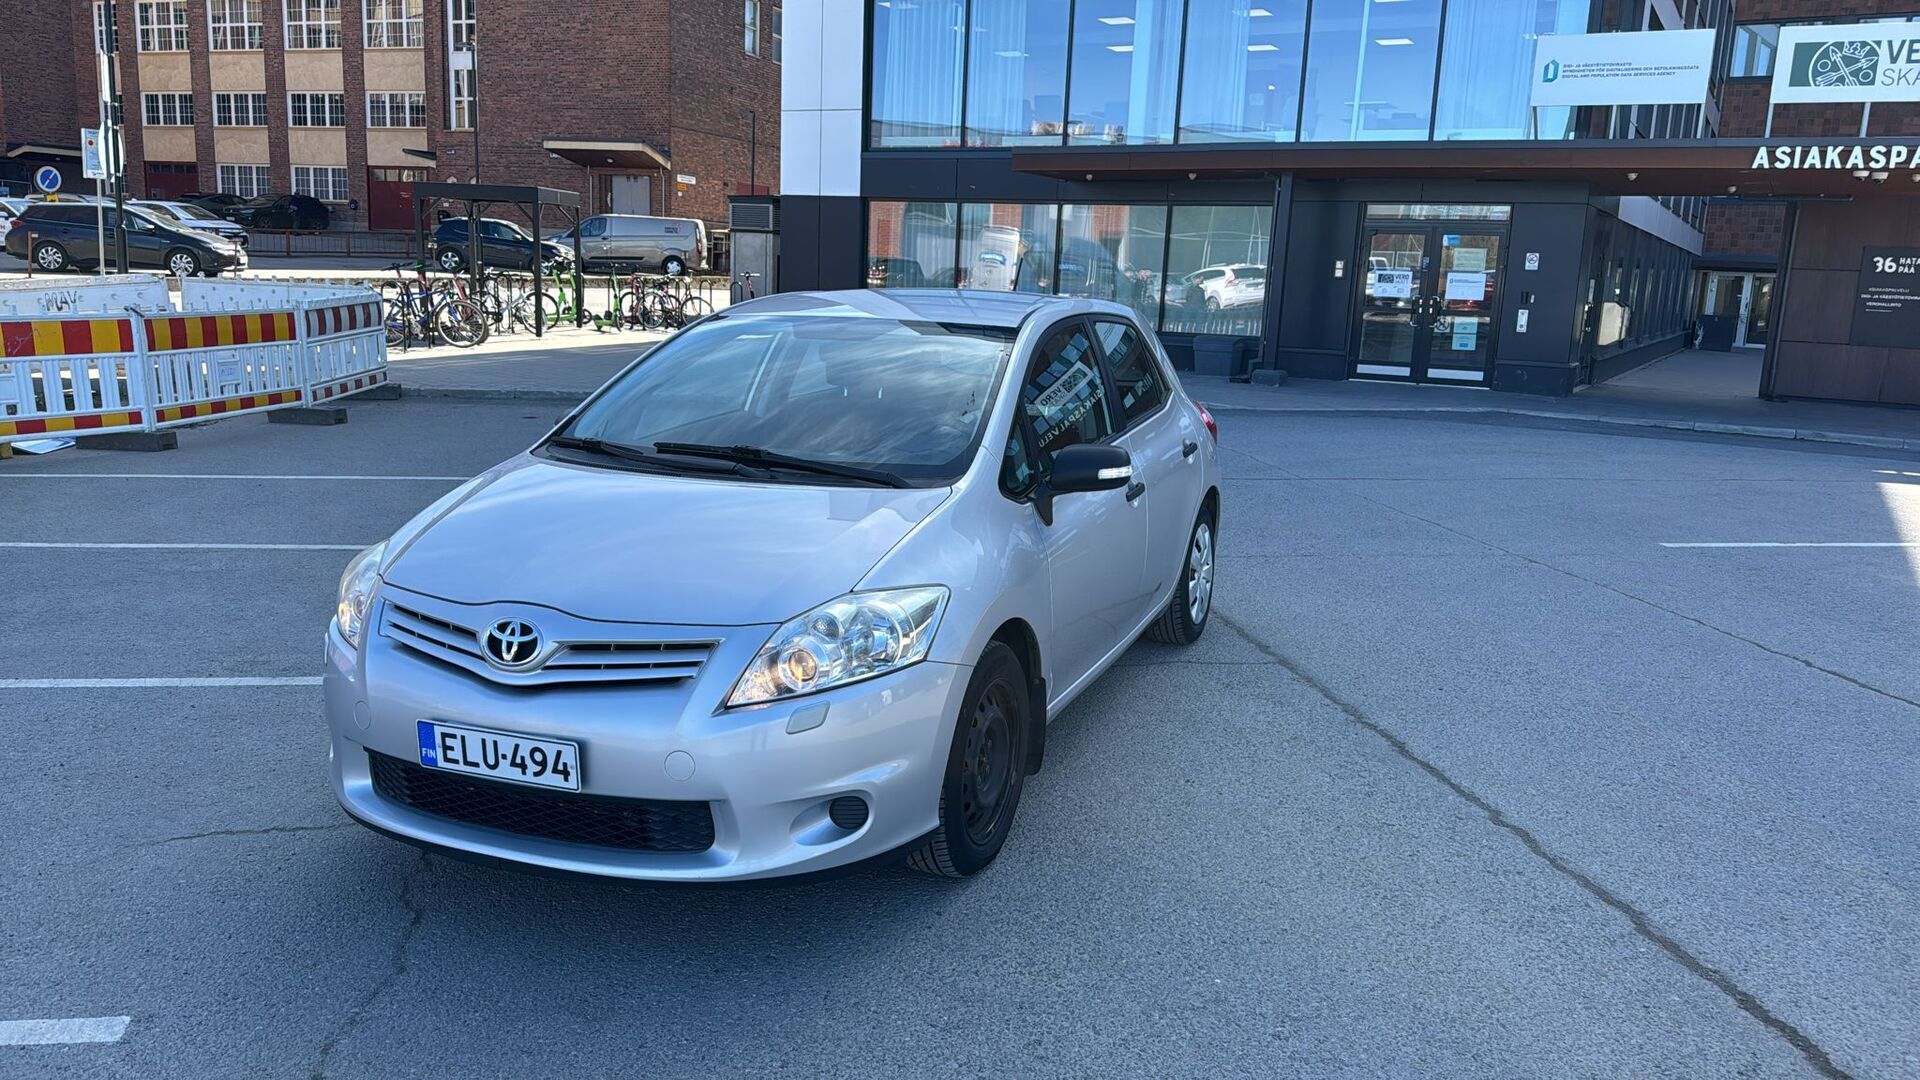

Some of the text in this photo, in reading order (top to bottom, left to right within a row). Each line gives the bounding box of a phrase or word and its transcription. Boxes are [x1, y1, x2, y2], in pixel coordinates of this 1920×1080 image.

[1887, 39, 1920, 64] VE
[1751, 145, 1920, 169] ASIAKASPA
[1873, 256, 1897, 273] 36
[1897, 264, 1915, 274] PÄÄ
[421, 747, 437, 760] FIN
[440, 731, 571, 783] ELU-494
